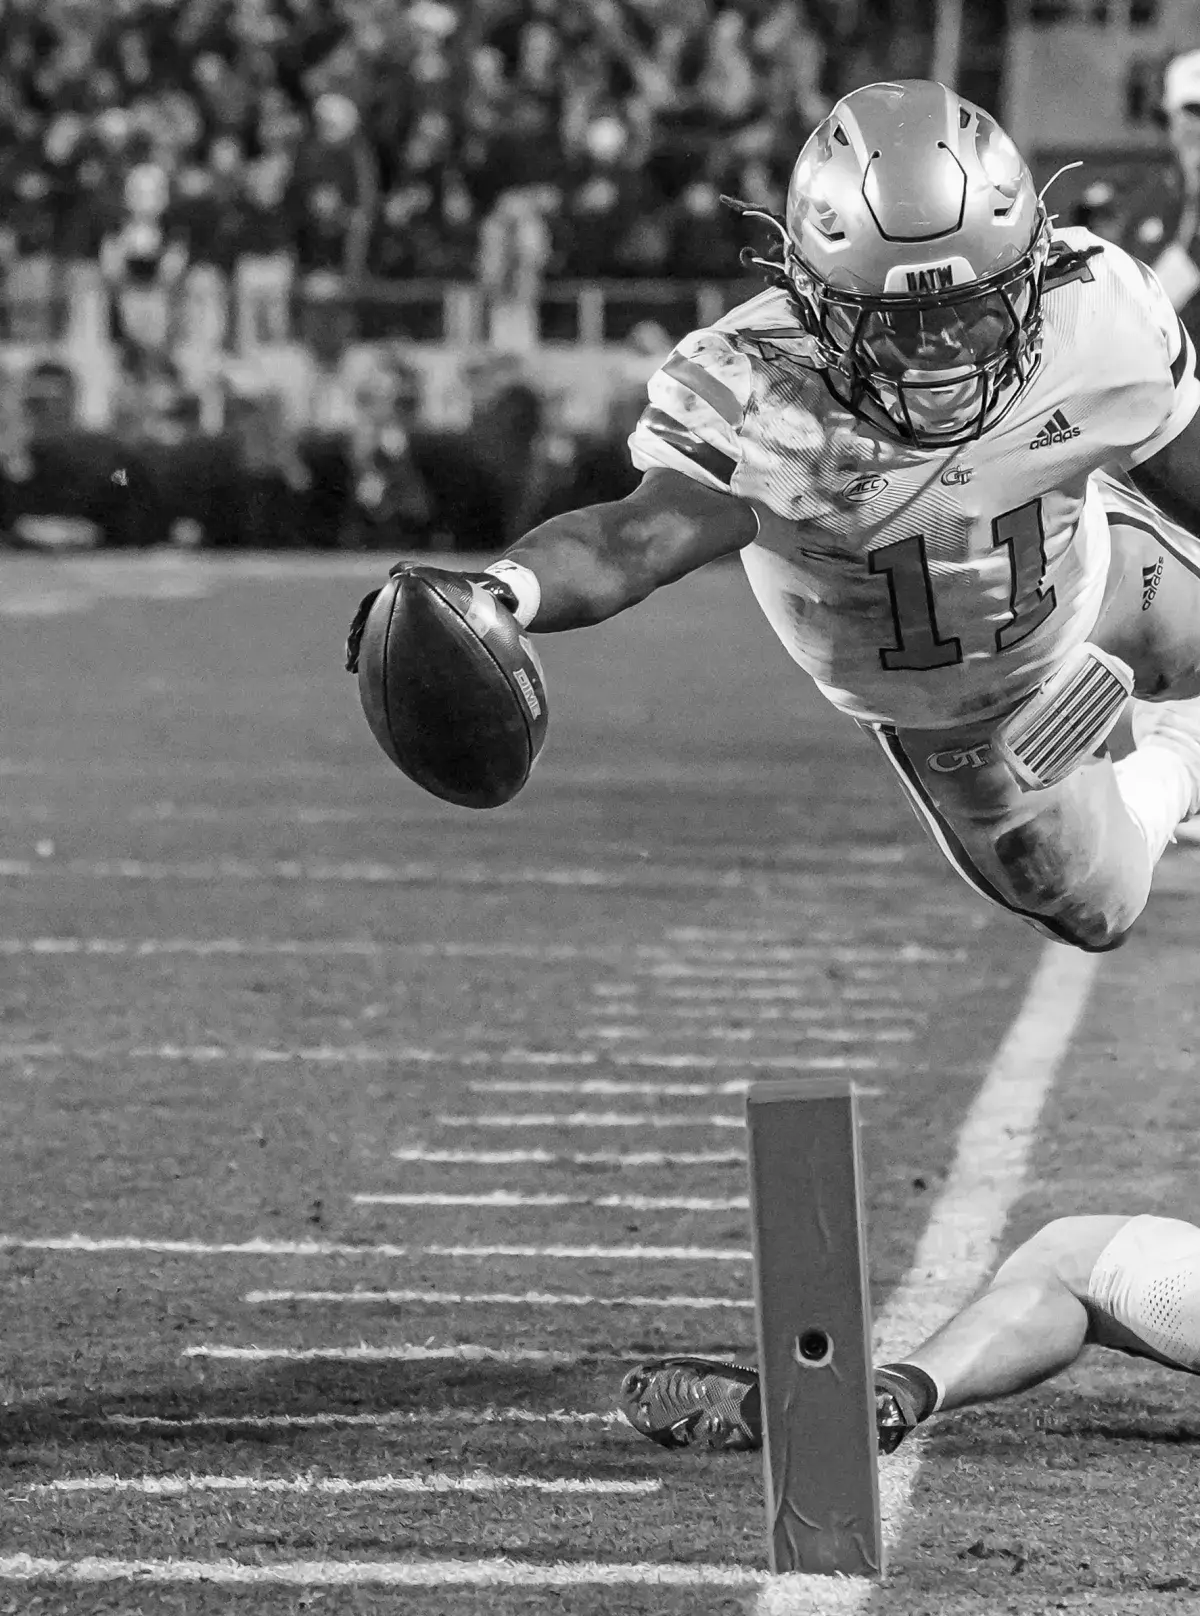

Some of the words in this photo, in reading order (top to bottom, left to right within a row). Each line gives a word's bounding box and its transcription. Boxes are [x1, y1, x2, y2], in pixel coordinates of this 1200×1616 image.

[1029, 424, 1081, 451] adidas
[849, 478, 882, 495] ACC
[941, 466, 974, 486] GT
[867, 497, 1057, 671] 11
[1142, 556, 1164, 612] adidas
[926, 743, 993, 773] GT
